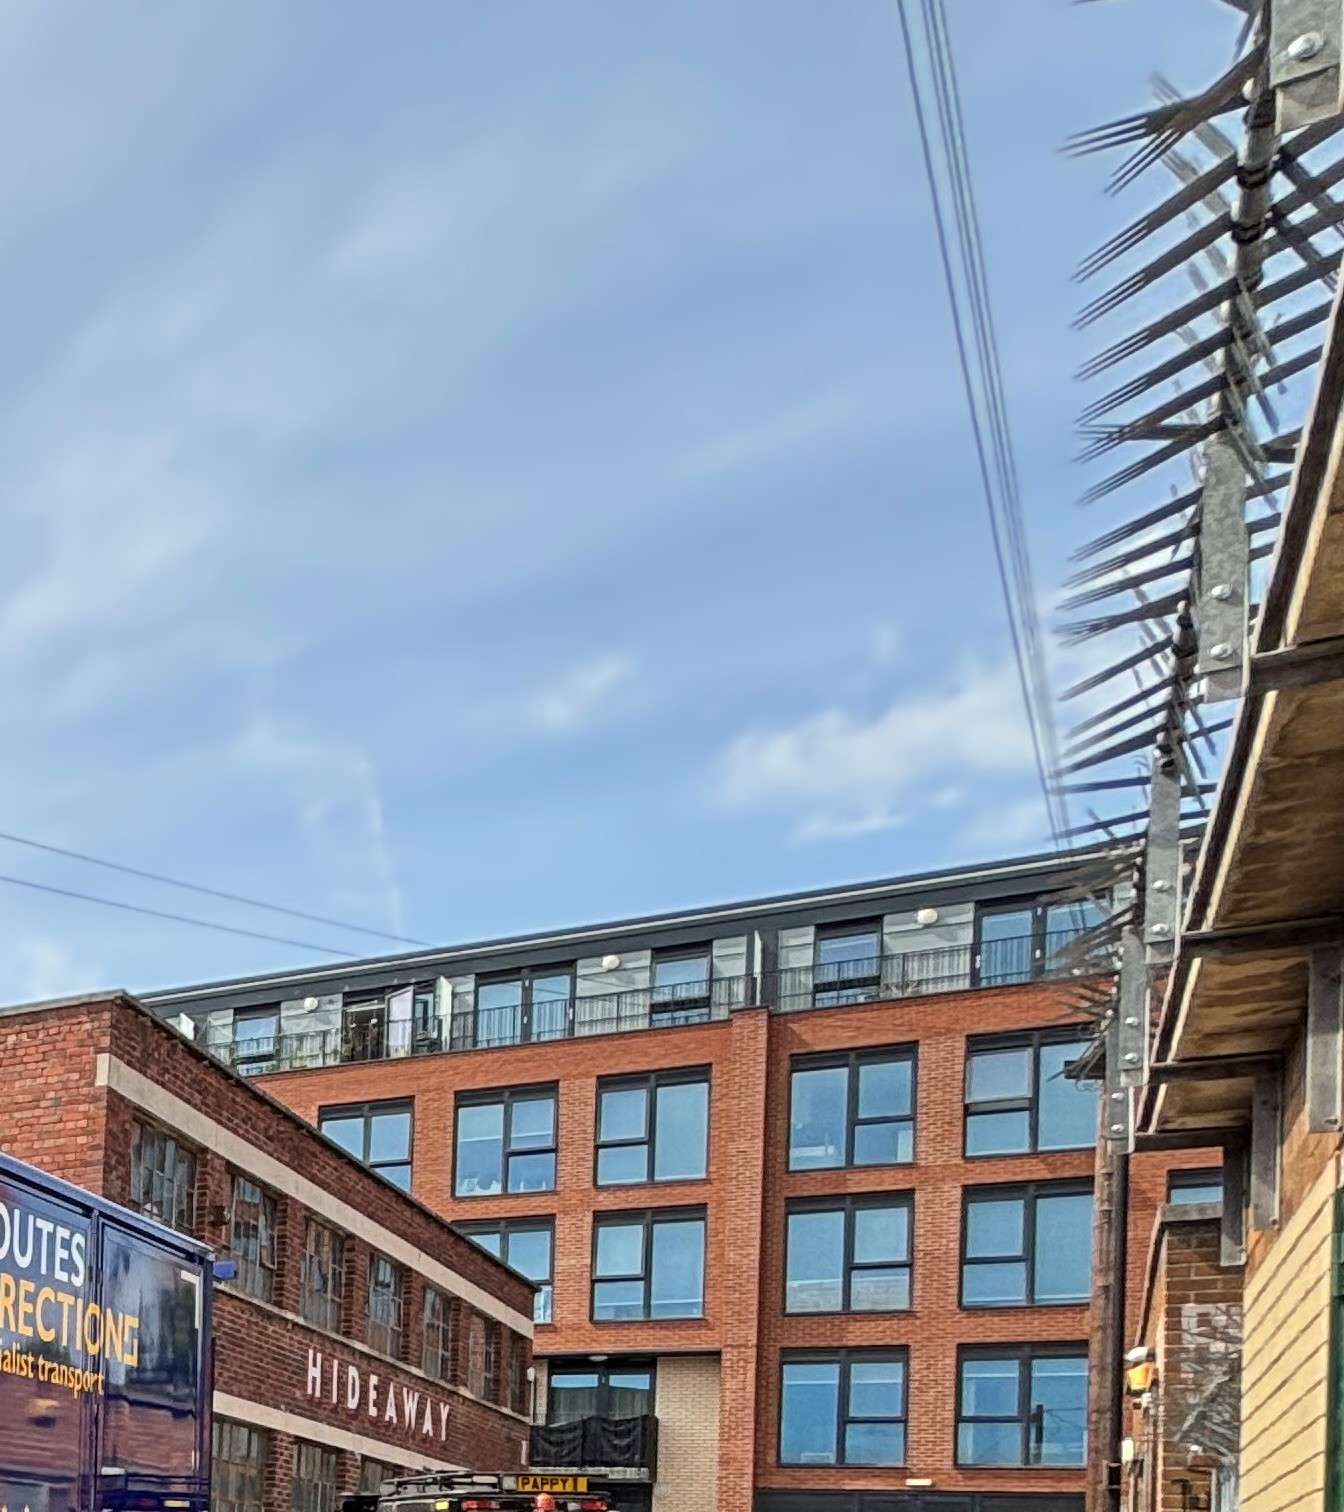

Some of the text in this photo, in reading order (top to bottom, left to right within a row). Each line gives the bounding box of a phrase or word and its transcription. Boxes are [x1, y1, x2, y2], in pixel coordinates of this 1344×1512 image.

[38, 1357, 105, 1399] transport
[307, 1349, 450, 1441] HIDEAWAY
[521, 1476, 570, 1491] PAPPY
